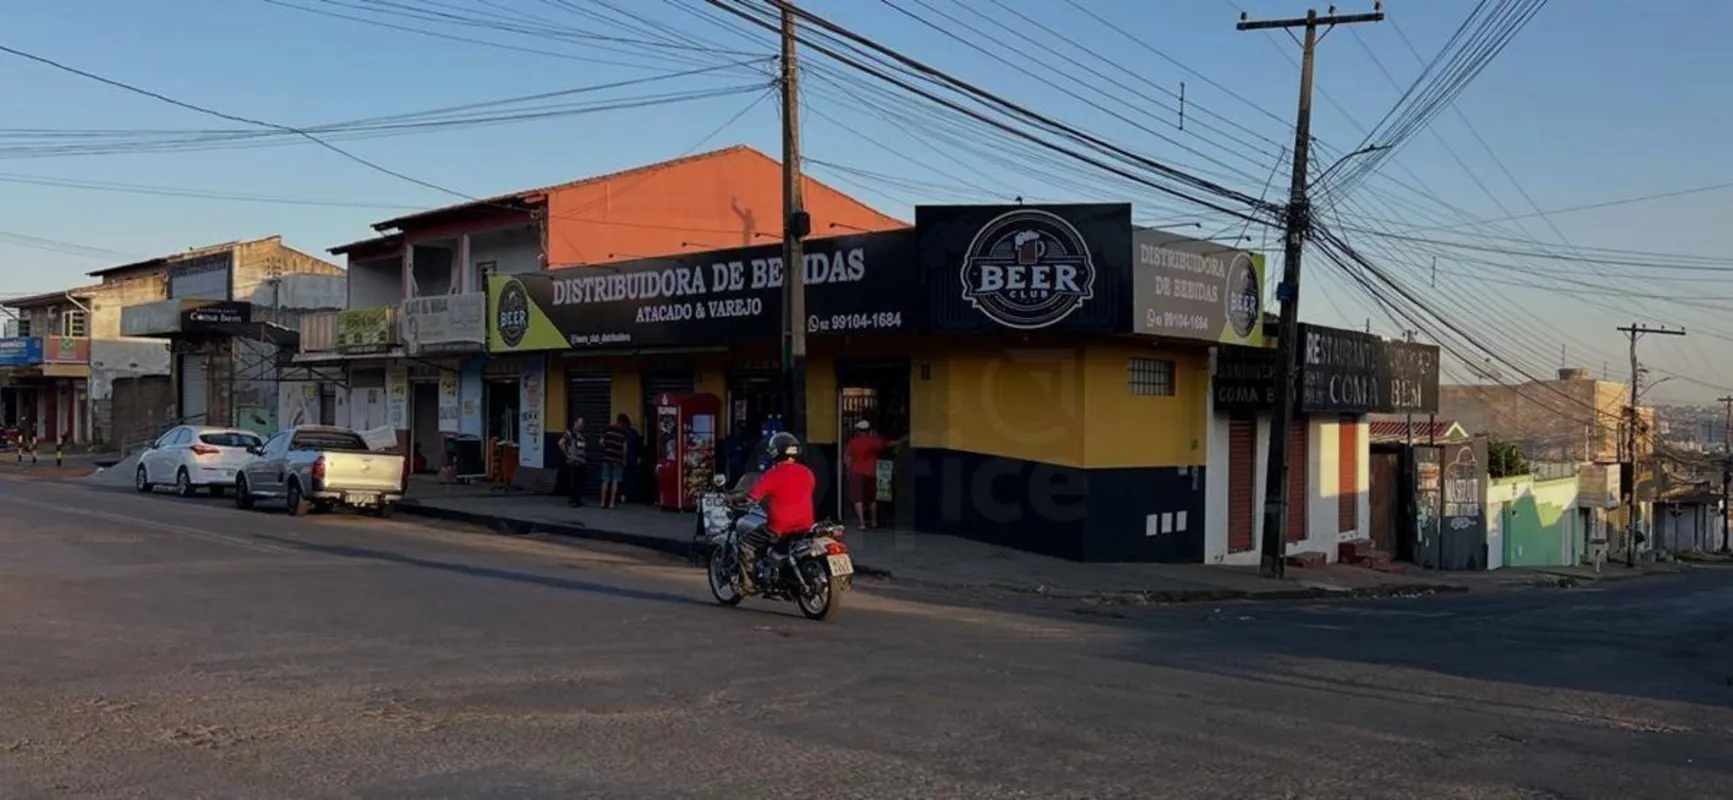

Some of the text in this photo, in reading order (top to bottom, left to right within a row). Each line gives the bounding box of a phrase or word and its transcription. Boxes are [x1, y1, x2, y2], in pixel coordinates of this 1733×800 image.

[1140, 243, 1226, 277] DISTRIBUIDORA
[552, 247, 866, 306] DISTRIBUIDORA DE BEIDAS
[974, 265, 1081, 293] BEER
[1155, 275, 1219, 303] DE BEBIDAS
[1009, 290, 1049, 299] CLUB
[1230, 292, 1257, 315] BEER
[499, 309, 528, 328] BEER
[635, 297, 762, 323] ATACADO & VAREJO
[831, 311, 902, 331] 99104-1684
[1329, 373, 1379, 406] COMA
[1390, 379, 1422, 408] BEM
